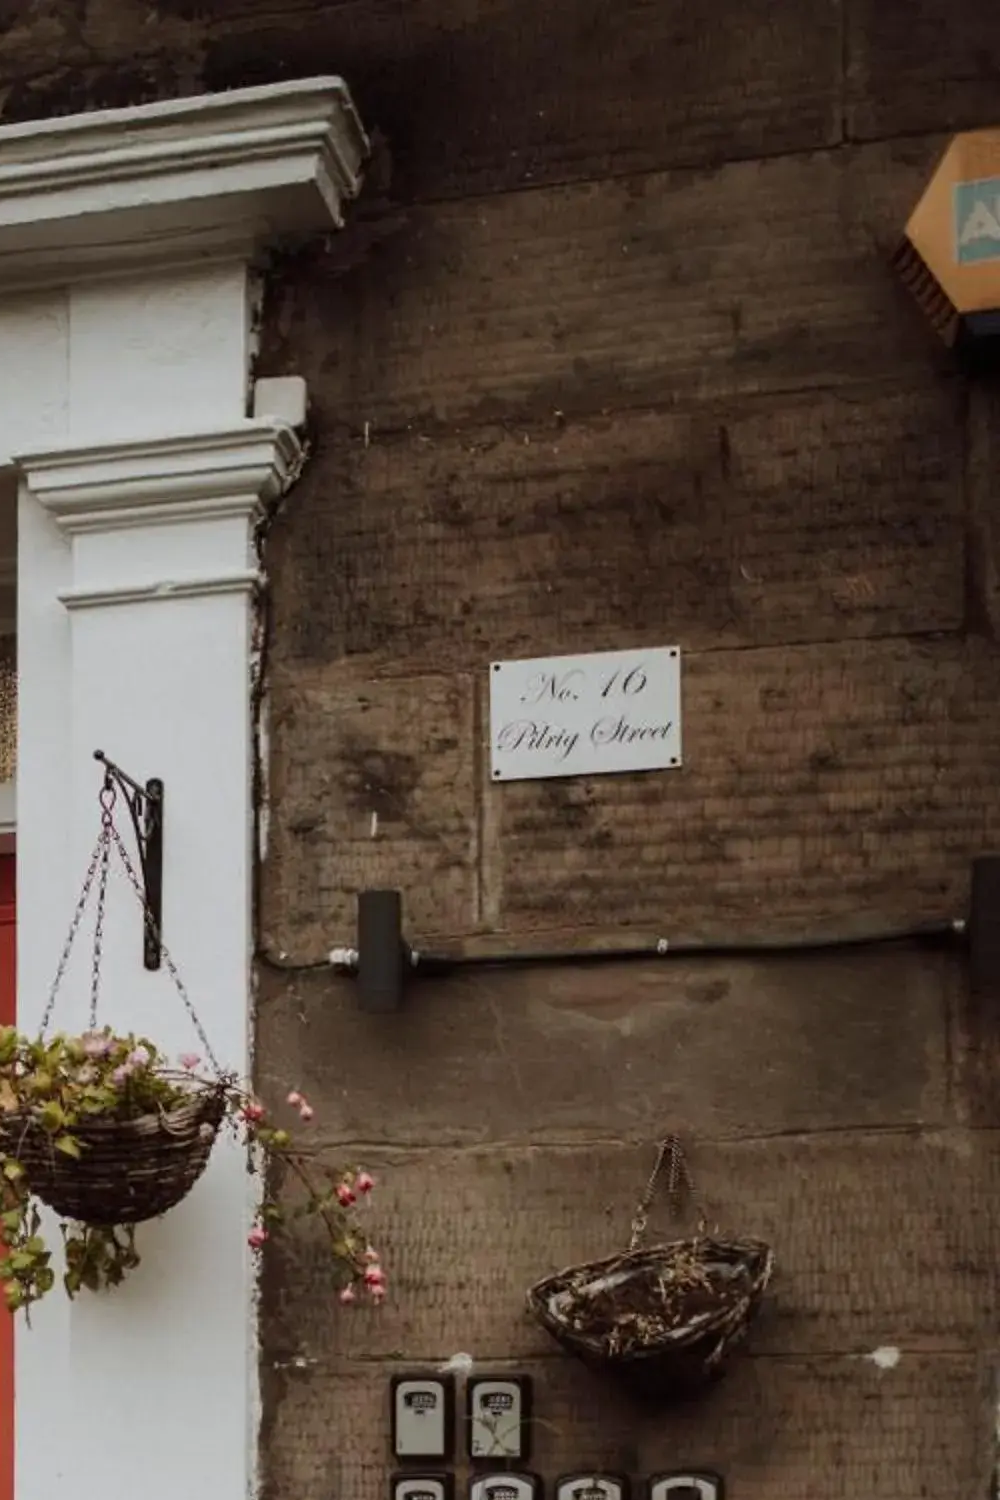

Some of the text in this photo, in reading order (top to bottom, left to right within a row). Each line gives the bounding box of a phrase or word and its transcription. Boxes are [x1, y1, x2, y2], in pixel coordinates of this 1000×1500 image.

[520, 662, 648, 703] No. 16
[497, 714, 674, 762] Pilrig Street
